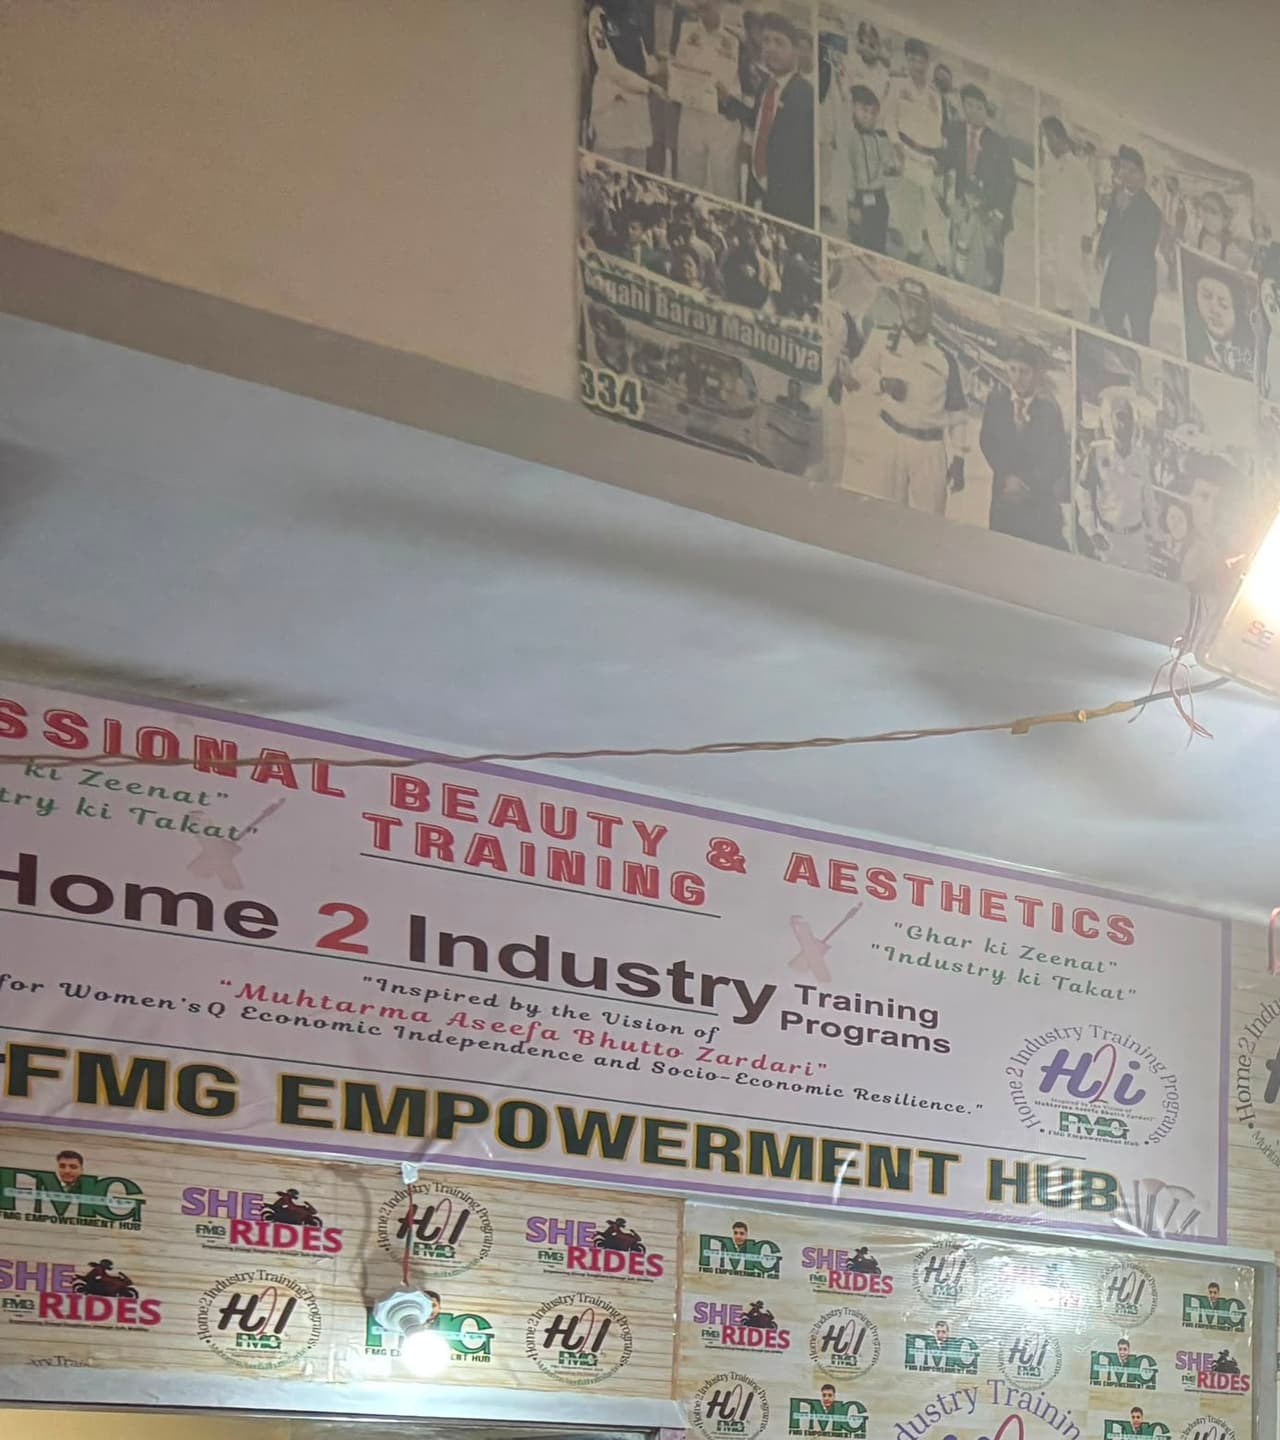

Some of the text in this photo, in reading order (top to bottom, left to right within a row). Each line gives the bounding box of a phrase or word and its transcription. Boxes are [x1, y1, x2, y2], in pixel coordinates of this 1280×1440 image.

[76, 796, 111, 819] ki
[362, 812, 706, 906] TRAINING
[390, 773, 668, 857] BEAUTY
[706, 836, 746, 874] &
[783, 851, 1135, 945] AESTHETICS
[0, 852, 777, 1025] Home 2 Industry
[984, 937, 1008, 956] ki
[1018, 968, 1041, 987] ki
[510, 996, 542, 1018] by
[551, 1003, 591, 1022] the
[602, 1011, 685, 1036] Vision
[694, 1024, 721, 1045] of
[794, 983, 939, 1030] Training
[0, 973, 45, 994] for
[240, 1005, 383, 1036] Economic
[393, 1025, 584, 1064] Independence
[593, 1053, 642, 1072] and
[651, 1060, 845, 1098] Socio-Economic
[447, 1010, 562, 1043] Aseefa
[572, 1027, 684, 1059] Bhutto
[780, 1010, 951, 1055] Programs
[278, 1071, 961, 1197] EMPOWERMENT
[986, 1157, 1121, 1212] HUB
[1059, 1111, 1130, 1140] FMG
[181, 1187, 264, 1222] SHE
[229, 1219, 343, 1253] RIDES
[526, 1216, 596, 1247] SHE
[566, 1247, 664, 1278] RIDES
[699, 1234, 783, 1273] FMG
[802, 1247, 848, 1270] SHE
[0, 1259, 75, 1293] SHE
[828, 1271, 894, 1295] RIDES
[38, 1292, 162, 1326] RIDES
[693, 1301, 743, 1326] SHE
[721, 1326, 791, 1349] RIDES
